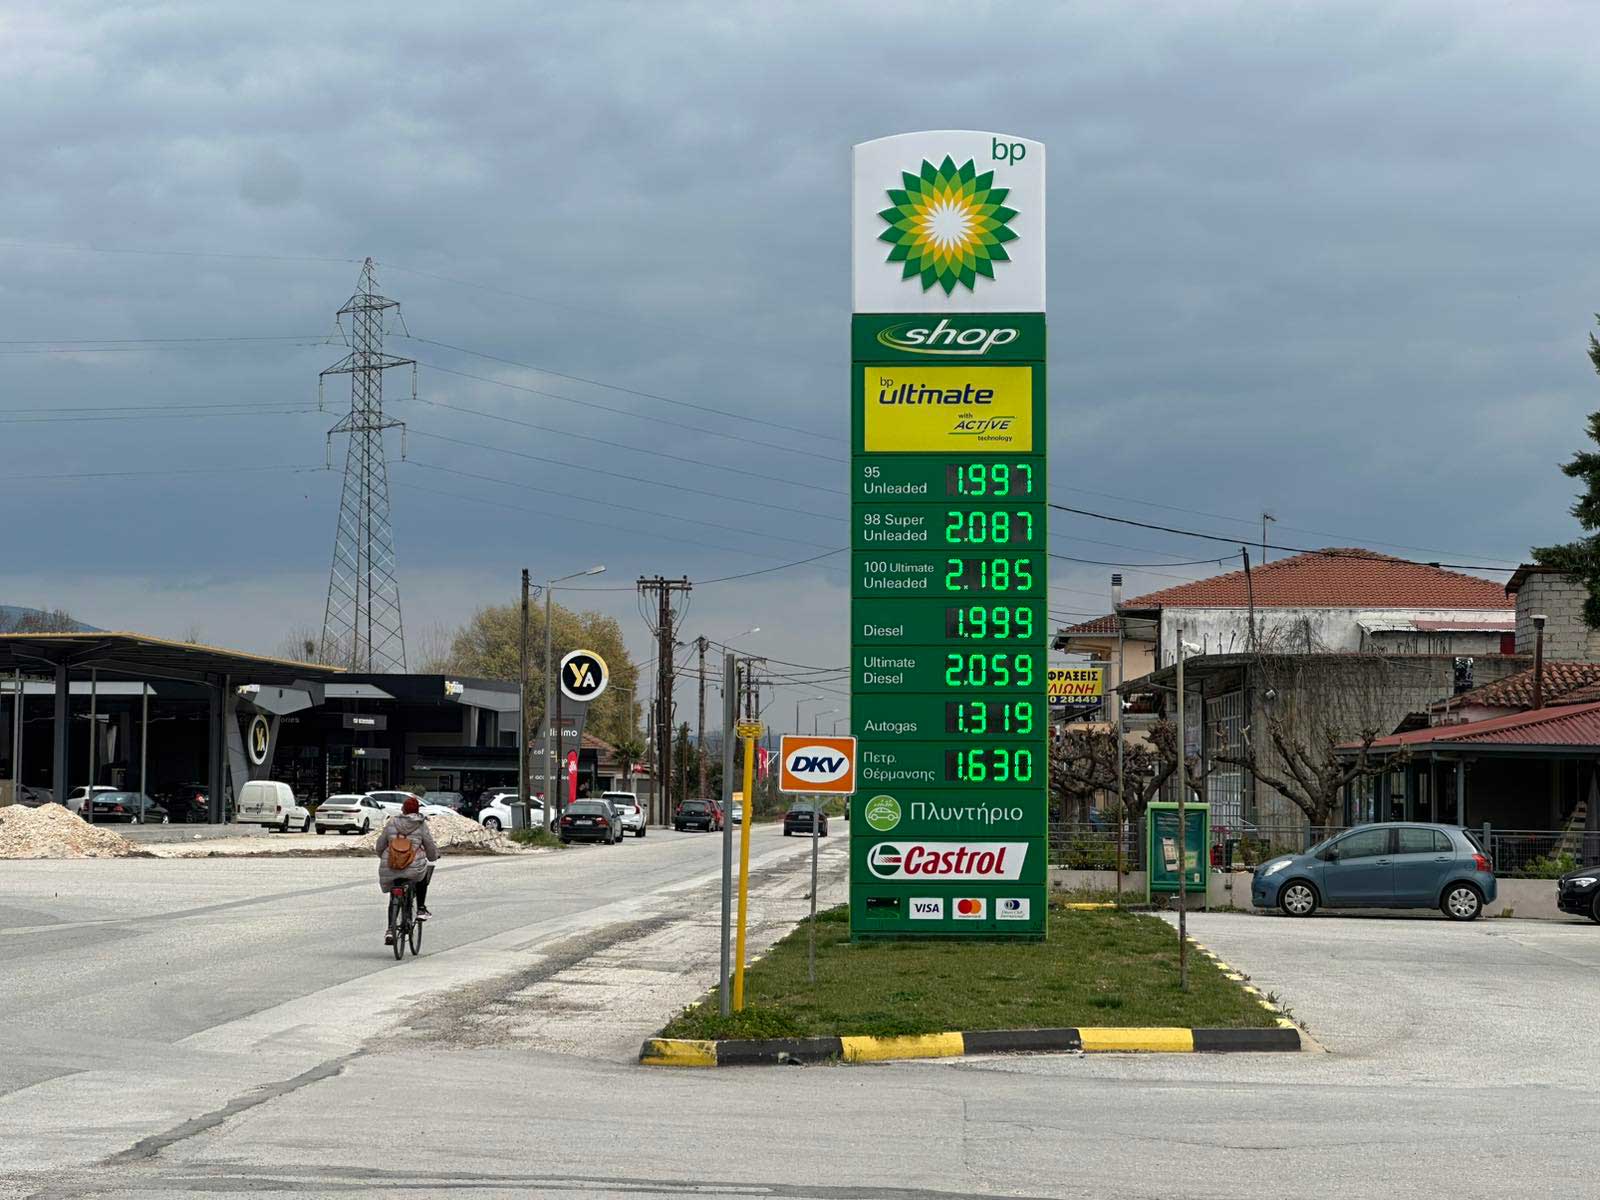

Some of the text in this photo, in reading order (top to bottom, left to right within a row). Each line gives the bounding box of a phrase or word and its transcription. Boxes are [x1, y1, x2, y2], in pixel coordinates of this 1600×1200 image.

[992, 137, 1026, 166] bp
[898, 319, 1019, 355] shop
[880, 377, 893, 388] bp
[879, 383, 993, 404] ultimate
[954, 419, 1012, 430] ACTIVE
[977, 435, 1013, 443] technology
[864, 467, 880, 477] 95
[957, 464, 1032, 495] 1.997
[864, 483, 927, 494] Unleaded
[864, 514, 924, 527] 98 Super
[946, 511, 1032, 543] 2.087
[864, 530, 927, 541] Unleaded
[864, 562, 934, 573] 100 Ultimate
[946, 559, 1032, 591] 2.185
[864, 578, 927, 589] Unleaded
[958, 607, 1032, 639] 1.999
[864, 625, 903, 636] Diesel
[864, 656, 915, 667] Ultimate
[569, 663, 596, 687] YA
[946, 654, 1032, 686] 2.059
[864, 673, 903, 684] Diesel
[1048, 683, 1095, 694] ΛΙΩΝΗ
[958, 702, 1033, 734] 1.319
[864, 720, 917, 734] Autogas
[790, 756, 845, 773] DKV
[864, 752, 897, 765] Πετρ.
[957, 749, 1032, 782] 1.630
[863, 767, 935, 781] Θέρμανσης
[911, 802, 1023, 824] Πλυντήριο
[903, 846, 1007, 875] Castrol
[914, 903, 940, 913] VISA
